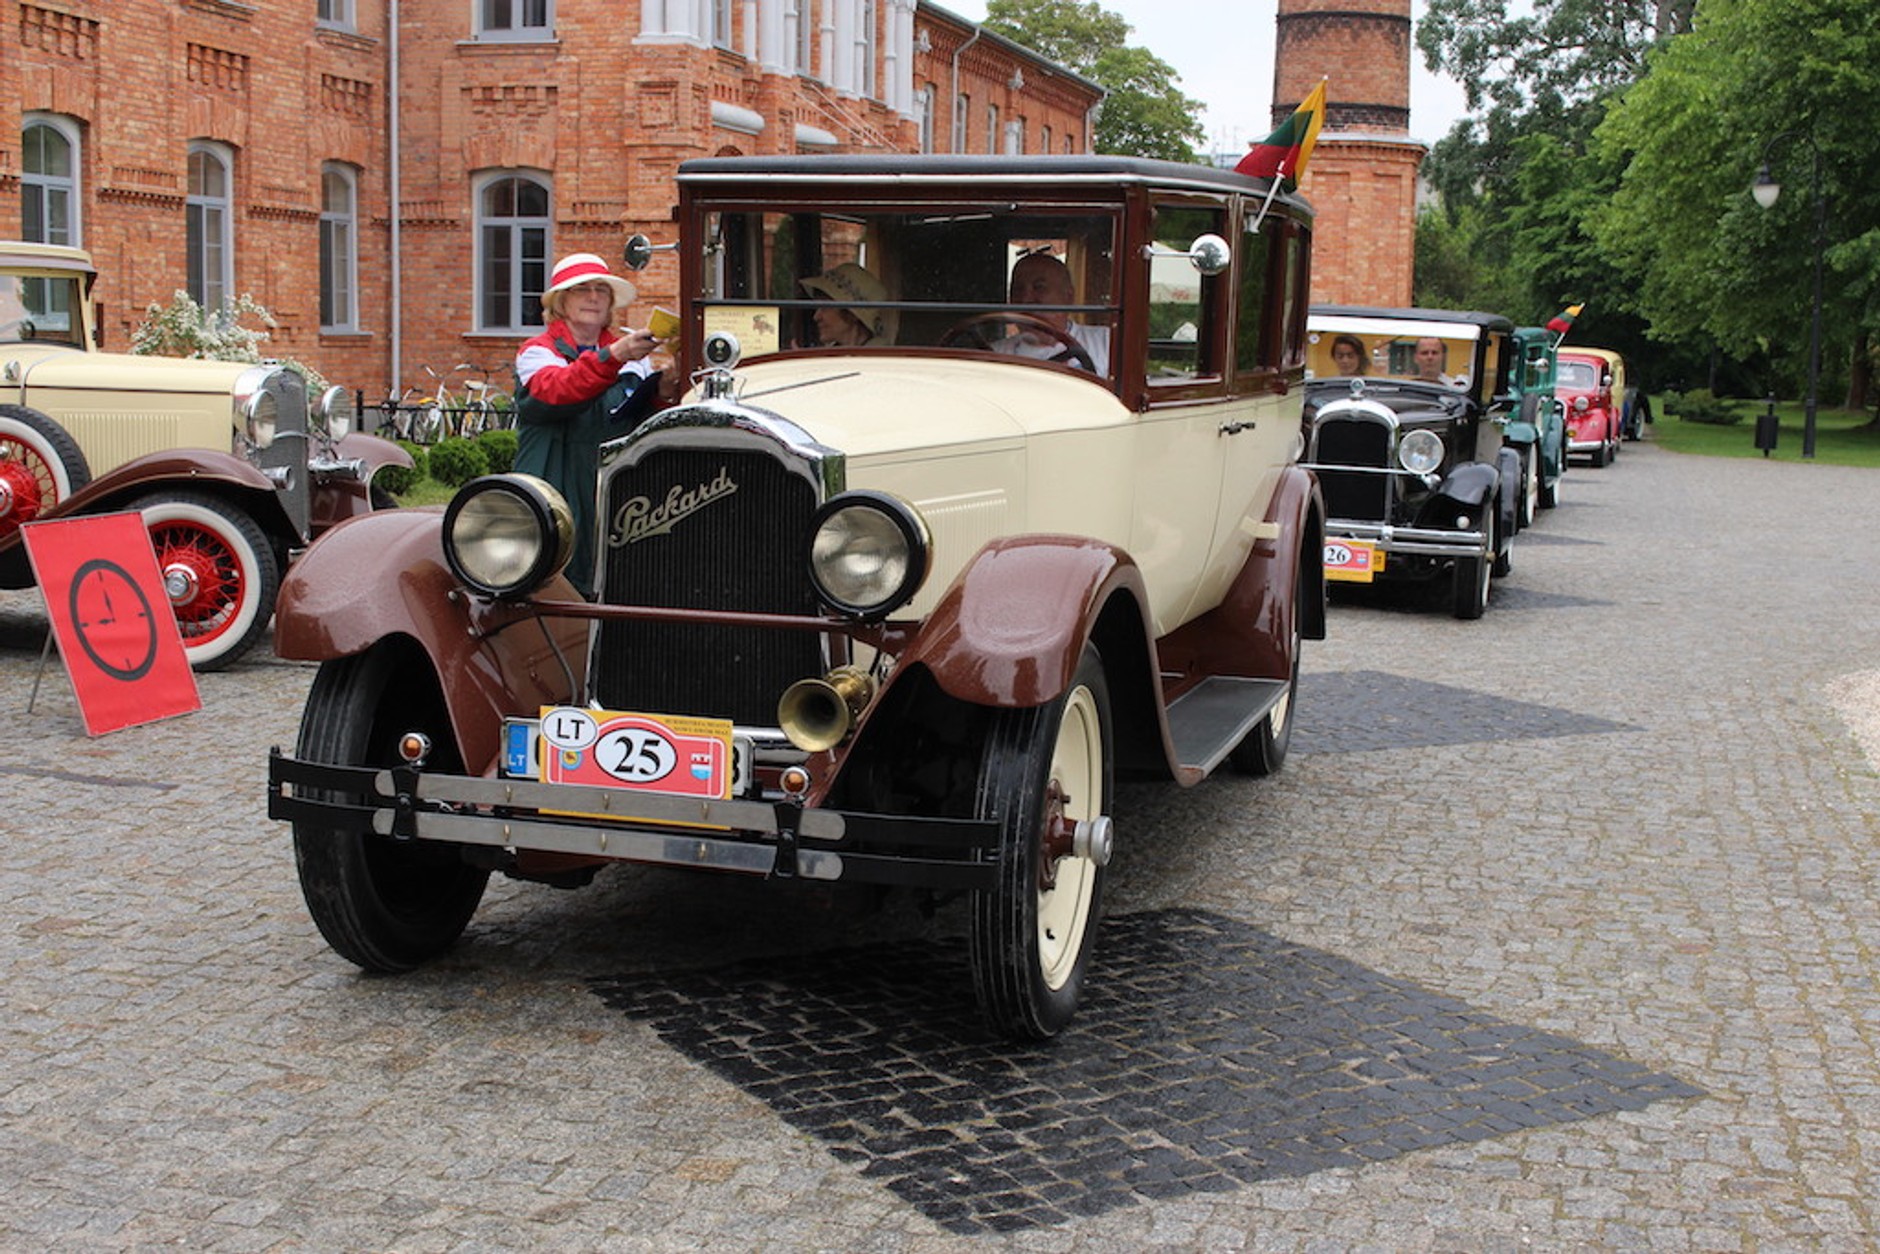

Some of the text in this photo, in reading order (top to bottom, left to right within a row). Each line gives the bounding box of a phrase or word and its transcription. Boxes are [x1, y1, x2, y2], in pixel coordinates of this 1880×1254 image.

[608, 466, 739, 547] Packard
[1327, 547, 1346, 562] 26
[556, 717, 585, 740] LT
[508, 753, 525, 767] LT
[613, 736, 661, 777] 25
